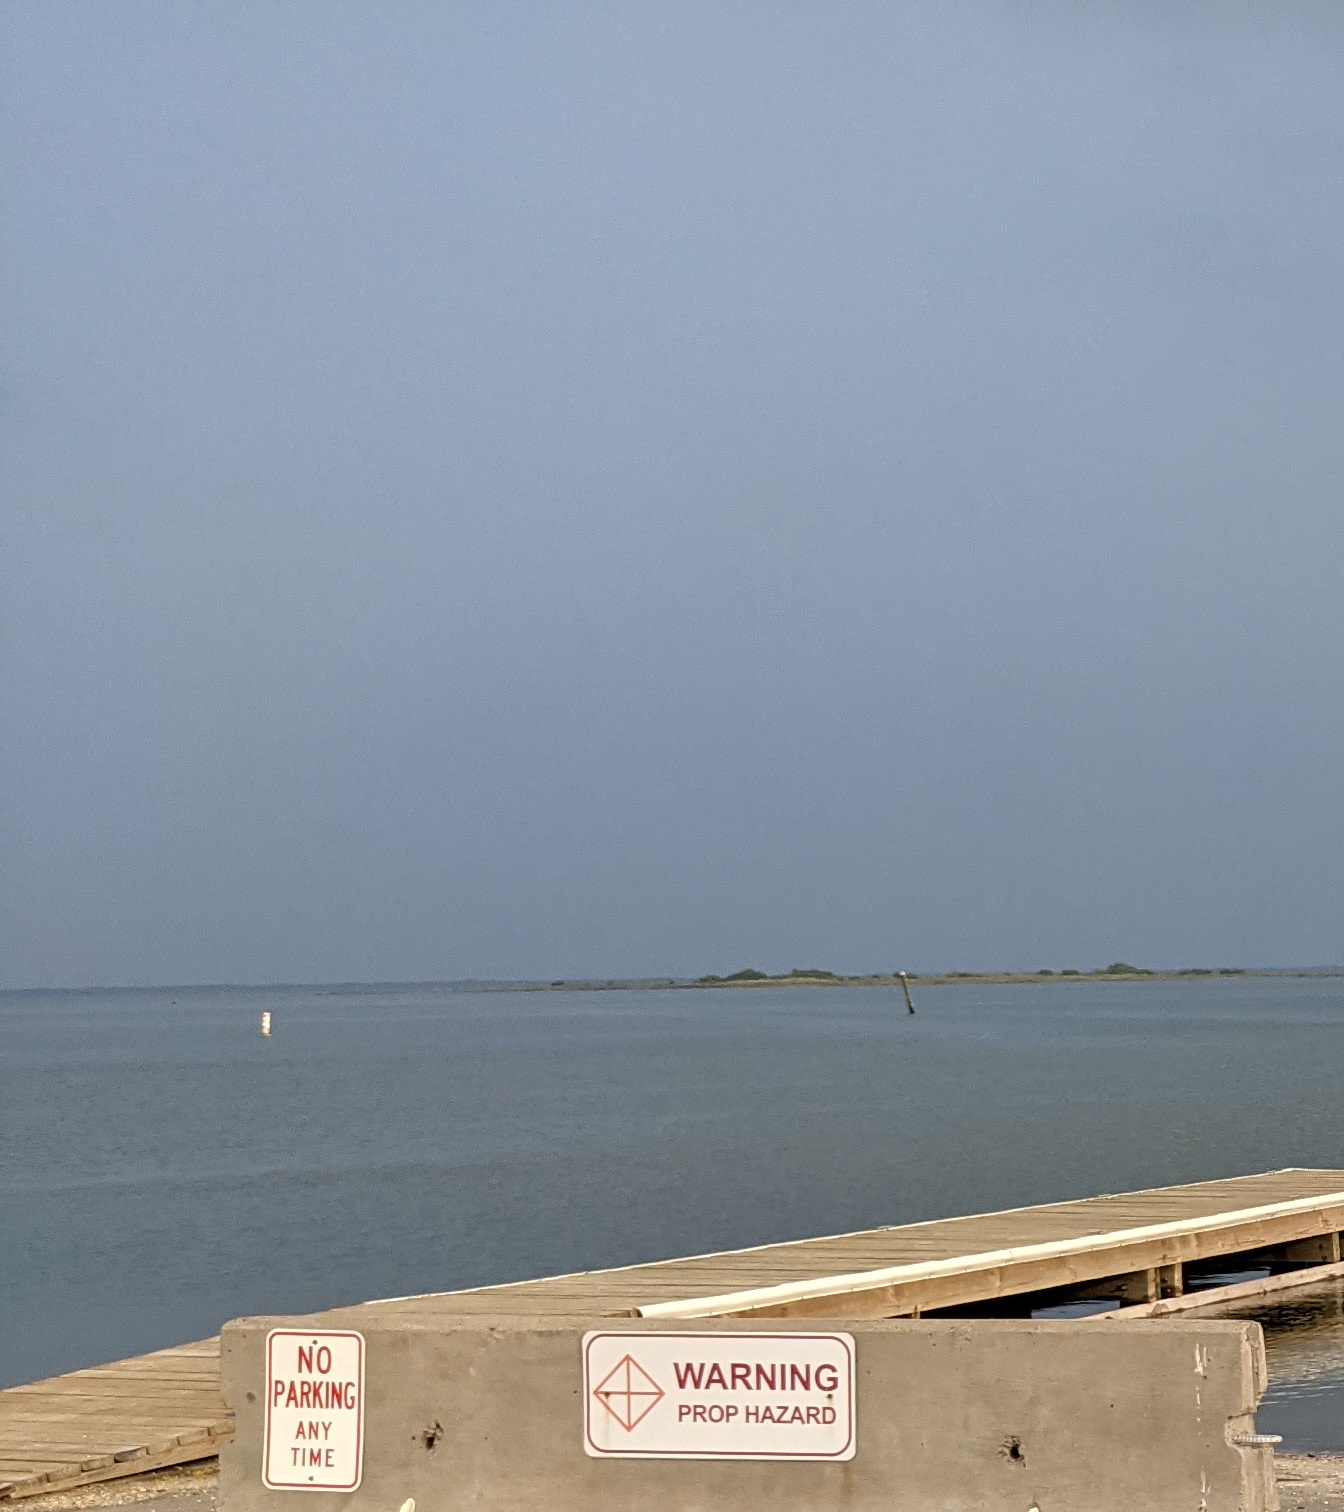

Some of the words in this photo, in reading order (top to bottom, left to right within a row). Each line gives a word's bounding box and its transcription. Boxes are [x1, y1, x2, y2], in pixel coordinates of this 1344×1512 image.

[298, 1346, 332, 1374] NO
[673, 1362, 839, 1392] WARNING
[273, 1379, 356, 1410] PARKING
[677, 1404, 739, 1423] PROP
[745, 1405, 837, 1425] HAZARD
[295, 1421, 332, 1440] ANY
[291, 1447, 335, 1467] TIME
